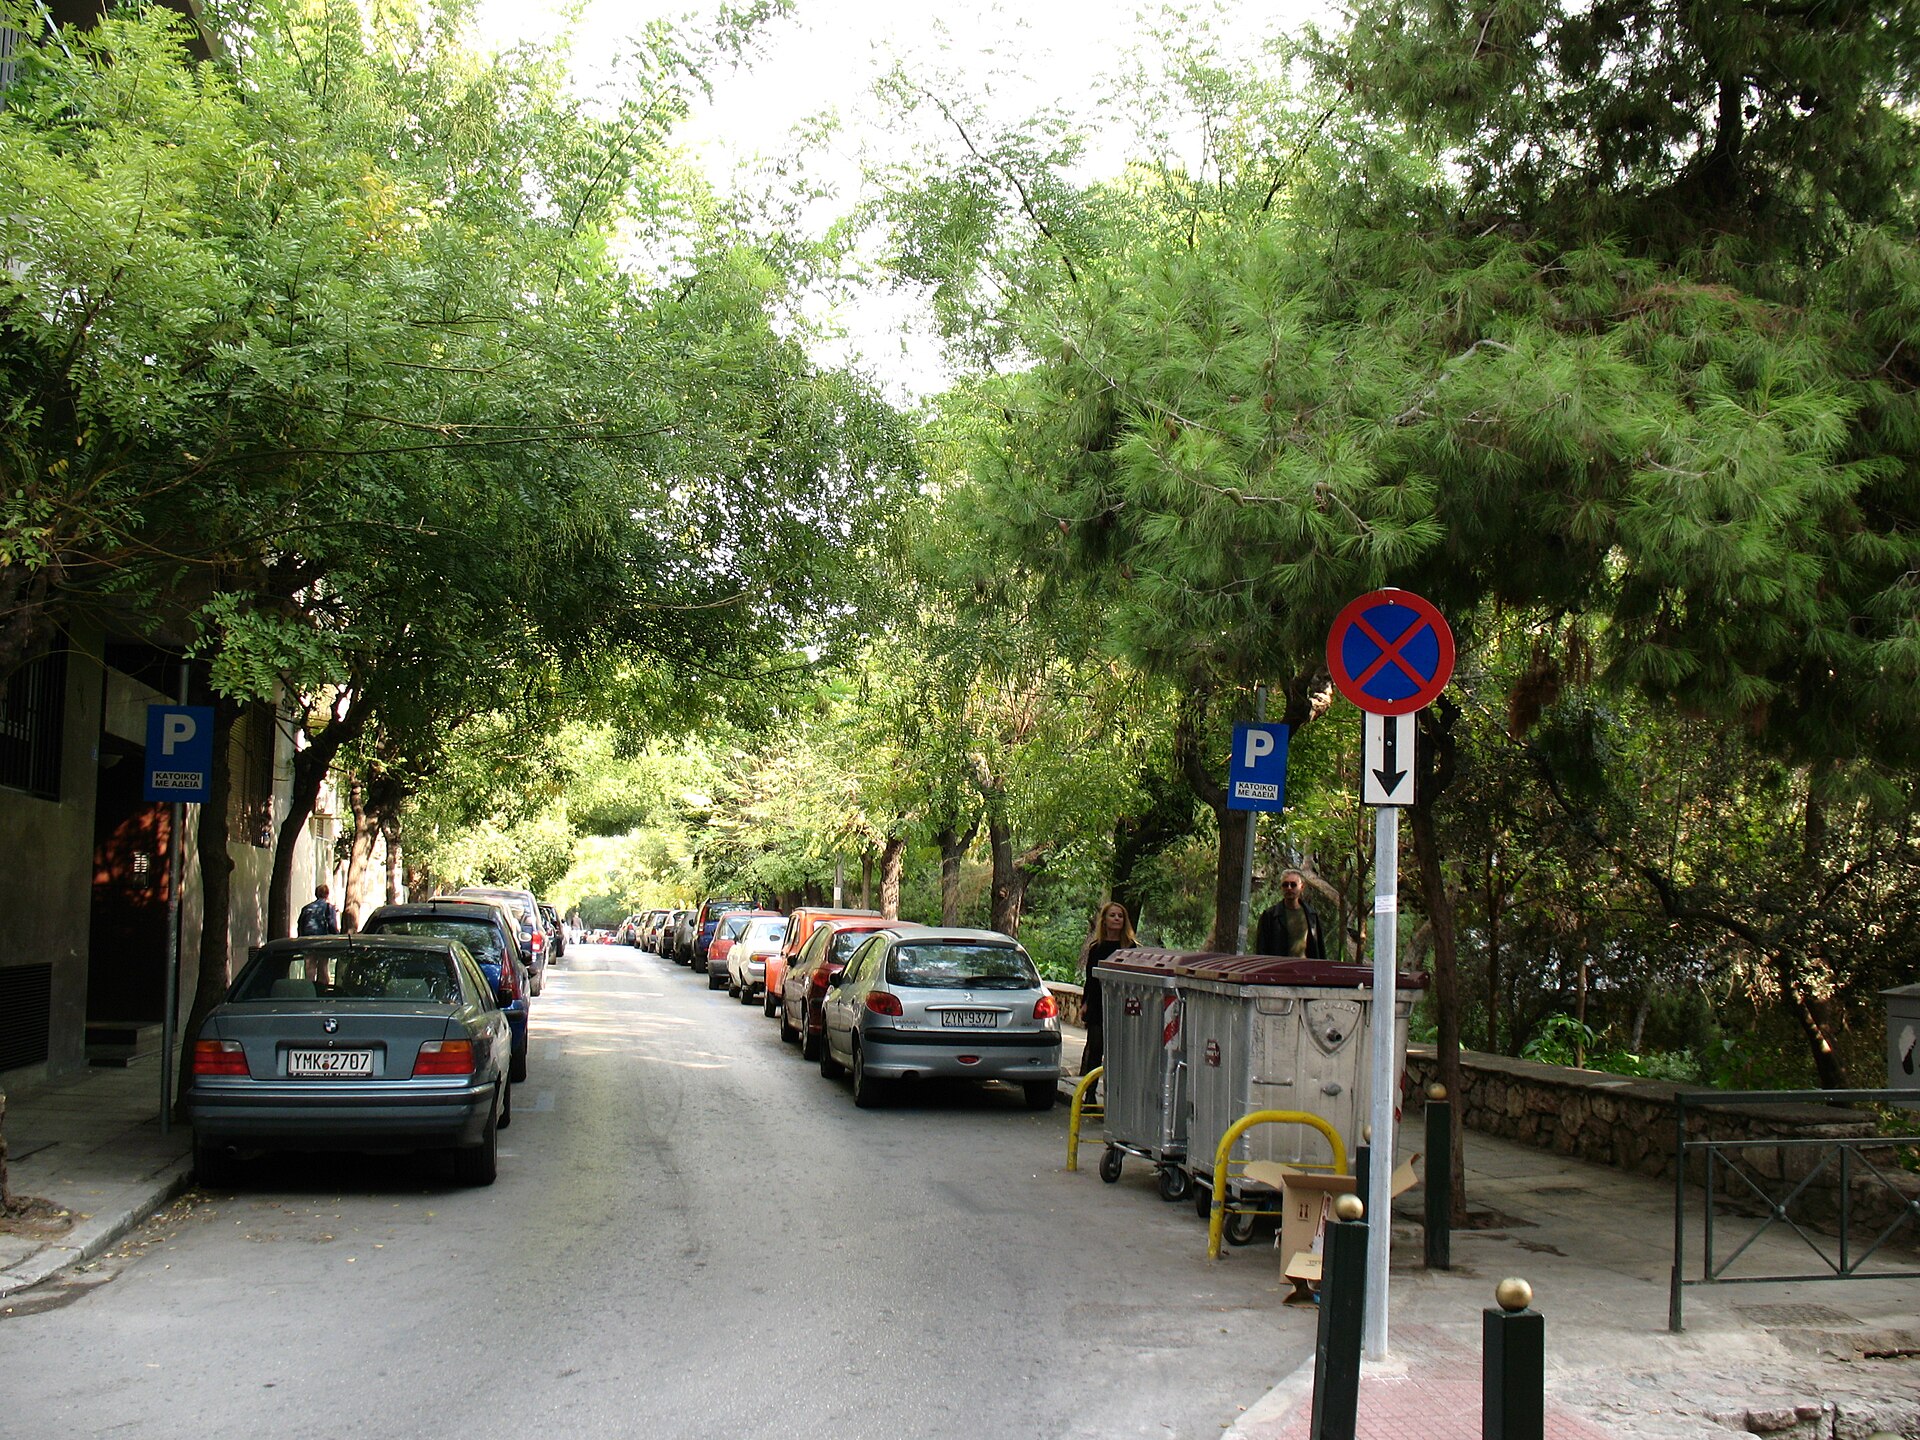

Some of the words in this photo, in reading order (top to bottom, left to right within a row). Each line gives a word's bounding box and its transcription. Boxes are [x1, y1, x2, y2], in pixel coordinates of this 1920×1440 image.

[162, 713, 197, 755] P
[1244, 729, 1275, 768] P
[155, 772, 200, 781] ΚΑΤΟΙΚΟΙ
[171, 780, 199, 788] ΑΔΕΙΑ
[1238, 782, 1276, 792] ΚΑΤΟΙΚΟΙ
[1237, 789, 1249, 797] ΜΕ
[1251, 790, 1275, 798] ΑΔΕΙΑ
